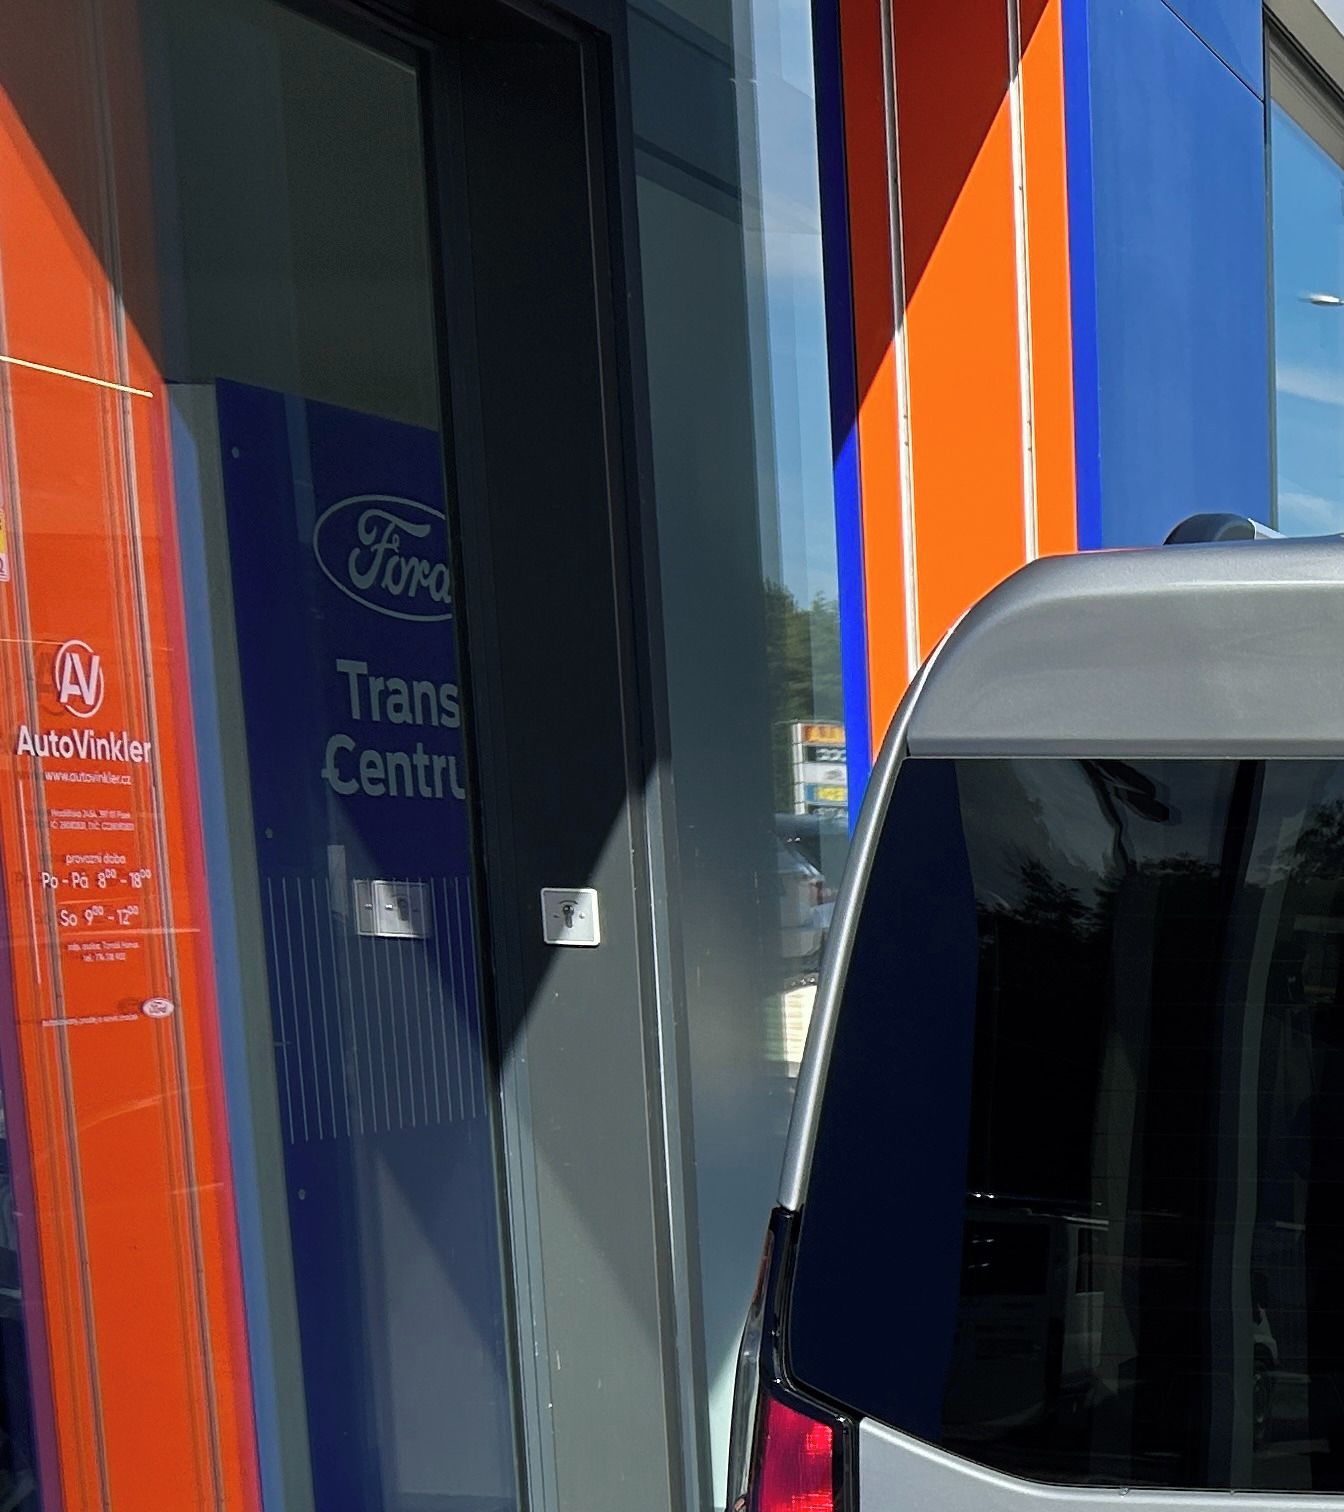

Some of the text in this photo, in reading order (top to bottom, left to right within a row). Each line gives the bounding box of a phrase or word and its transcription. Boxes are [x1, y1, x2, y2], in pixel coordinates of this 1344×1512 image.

[336, 658, 462, 729] Trans
[17, 725, 151, 763] AutoVinkler
[44, 771, 132, 786] www.autovinkler.cz
[41, 872, 59, 889] Po
[72, 871, 89, 889] Pá
[60, 909, 78, 927] So
